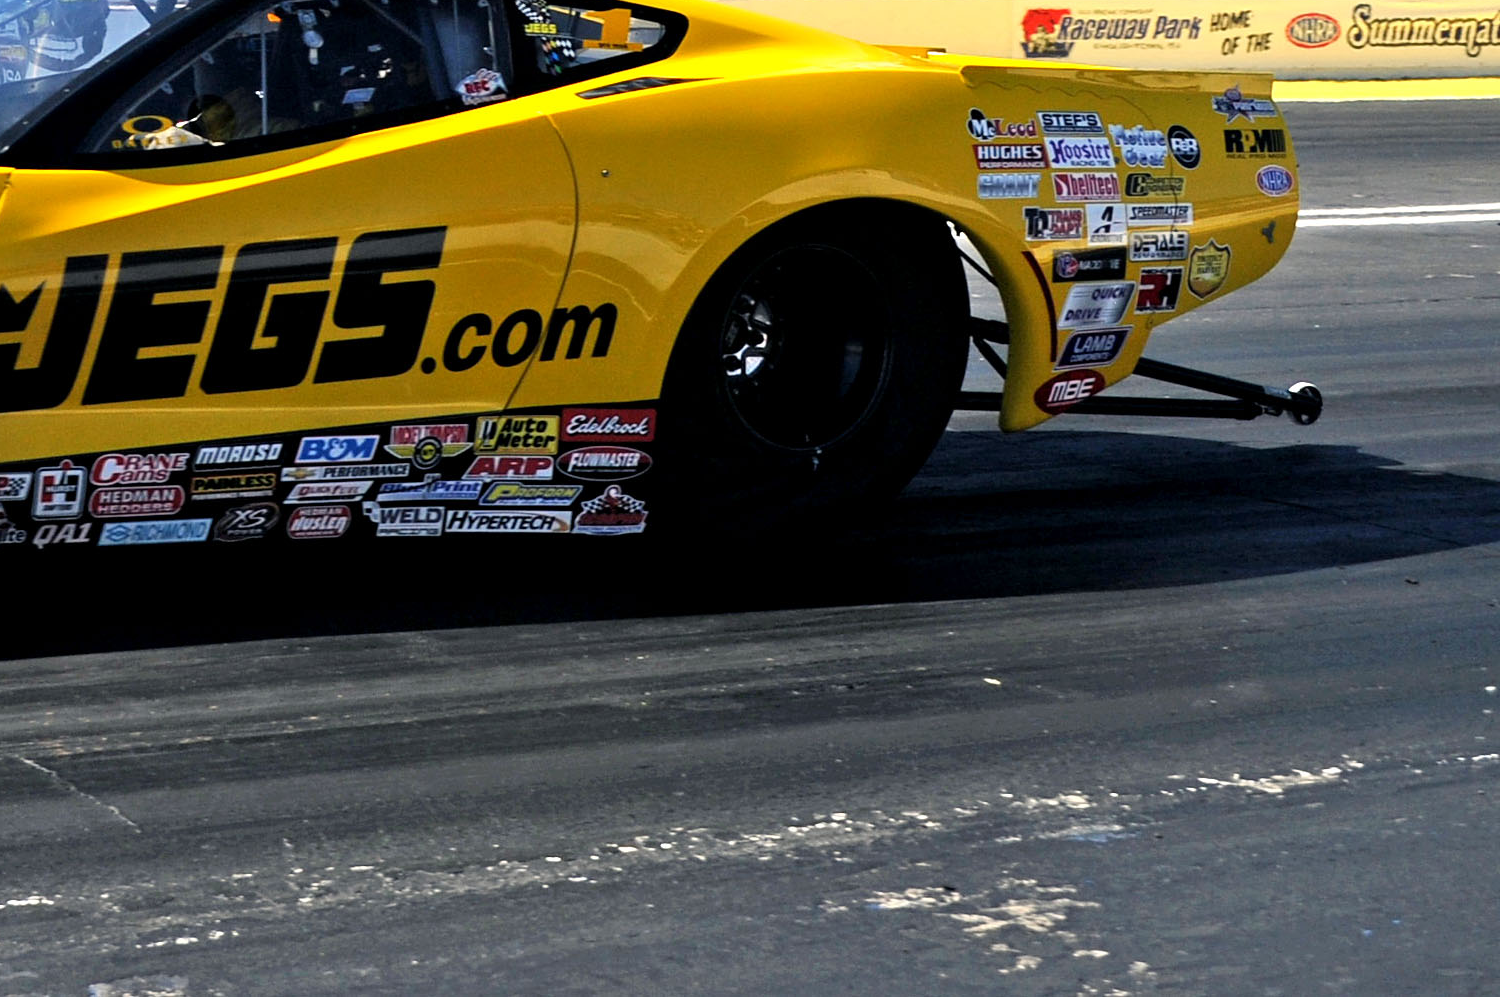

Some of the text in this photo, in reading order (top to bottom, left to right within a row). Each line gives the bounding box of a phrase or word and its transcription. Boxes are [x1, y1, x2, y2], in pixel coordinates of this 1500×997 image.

[525, 23, 557, 34] JEGS
[1057, 15, 1202, 41] Raceway Park
[1210, 10, 1252, 32] HOME
[1290, 17, 1338, 44] NHRA
[1222, 33, 1274, 56] OF THE
[971, 118, 1037, 139] McLeod
[1041, 114, 1098, 126] STEF'S
[977, 145, 1042, 159] HUGHES
[1261, 168, 1289, 190] NHRA
[1092, 287, 1127, 300] QUICK
[1065, 307, 1103, 321] DRIVE
[1074, 334, 1117, 353] LAMB
[1048, 377, 1097, 403] MBE
[501, 418, 548, 434] Auto
[566, 414, 650, 435] Edelbrock
[300, 437, 376, 461] B&M
[499, 433, 556, 449] Meter
[195, 445, 282, 464] MOROSO
[566, 452, 642, 472] FLOWMASTER
[323, 465, 409, 478] PERFORMANCE
[467, 457, 551, 476] ARP
[194, 476, 275, 491] PAINLESS
[100, 488, 176, 504] HEDMAN
[227, 508, 269, 528] XS
[380, 509, 443, 524] WELD
[448, 510, 555, 530] HYPERTECH
[32, 523, 93, 549] QA1
[133, 520, 208, 540] RICHMOND
